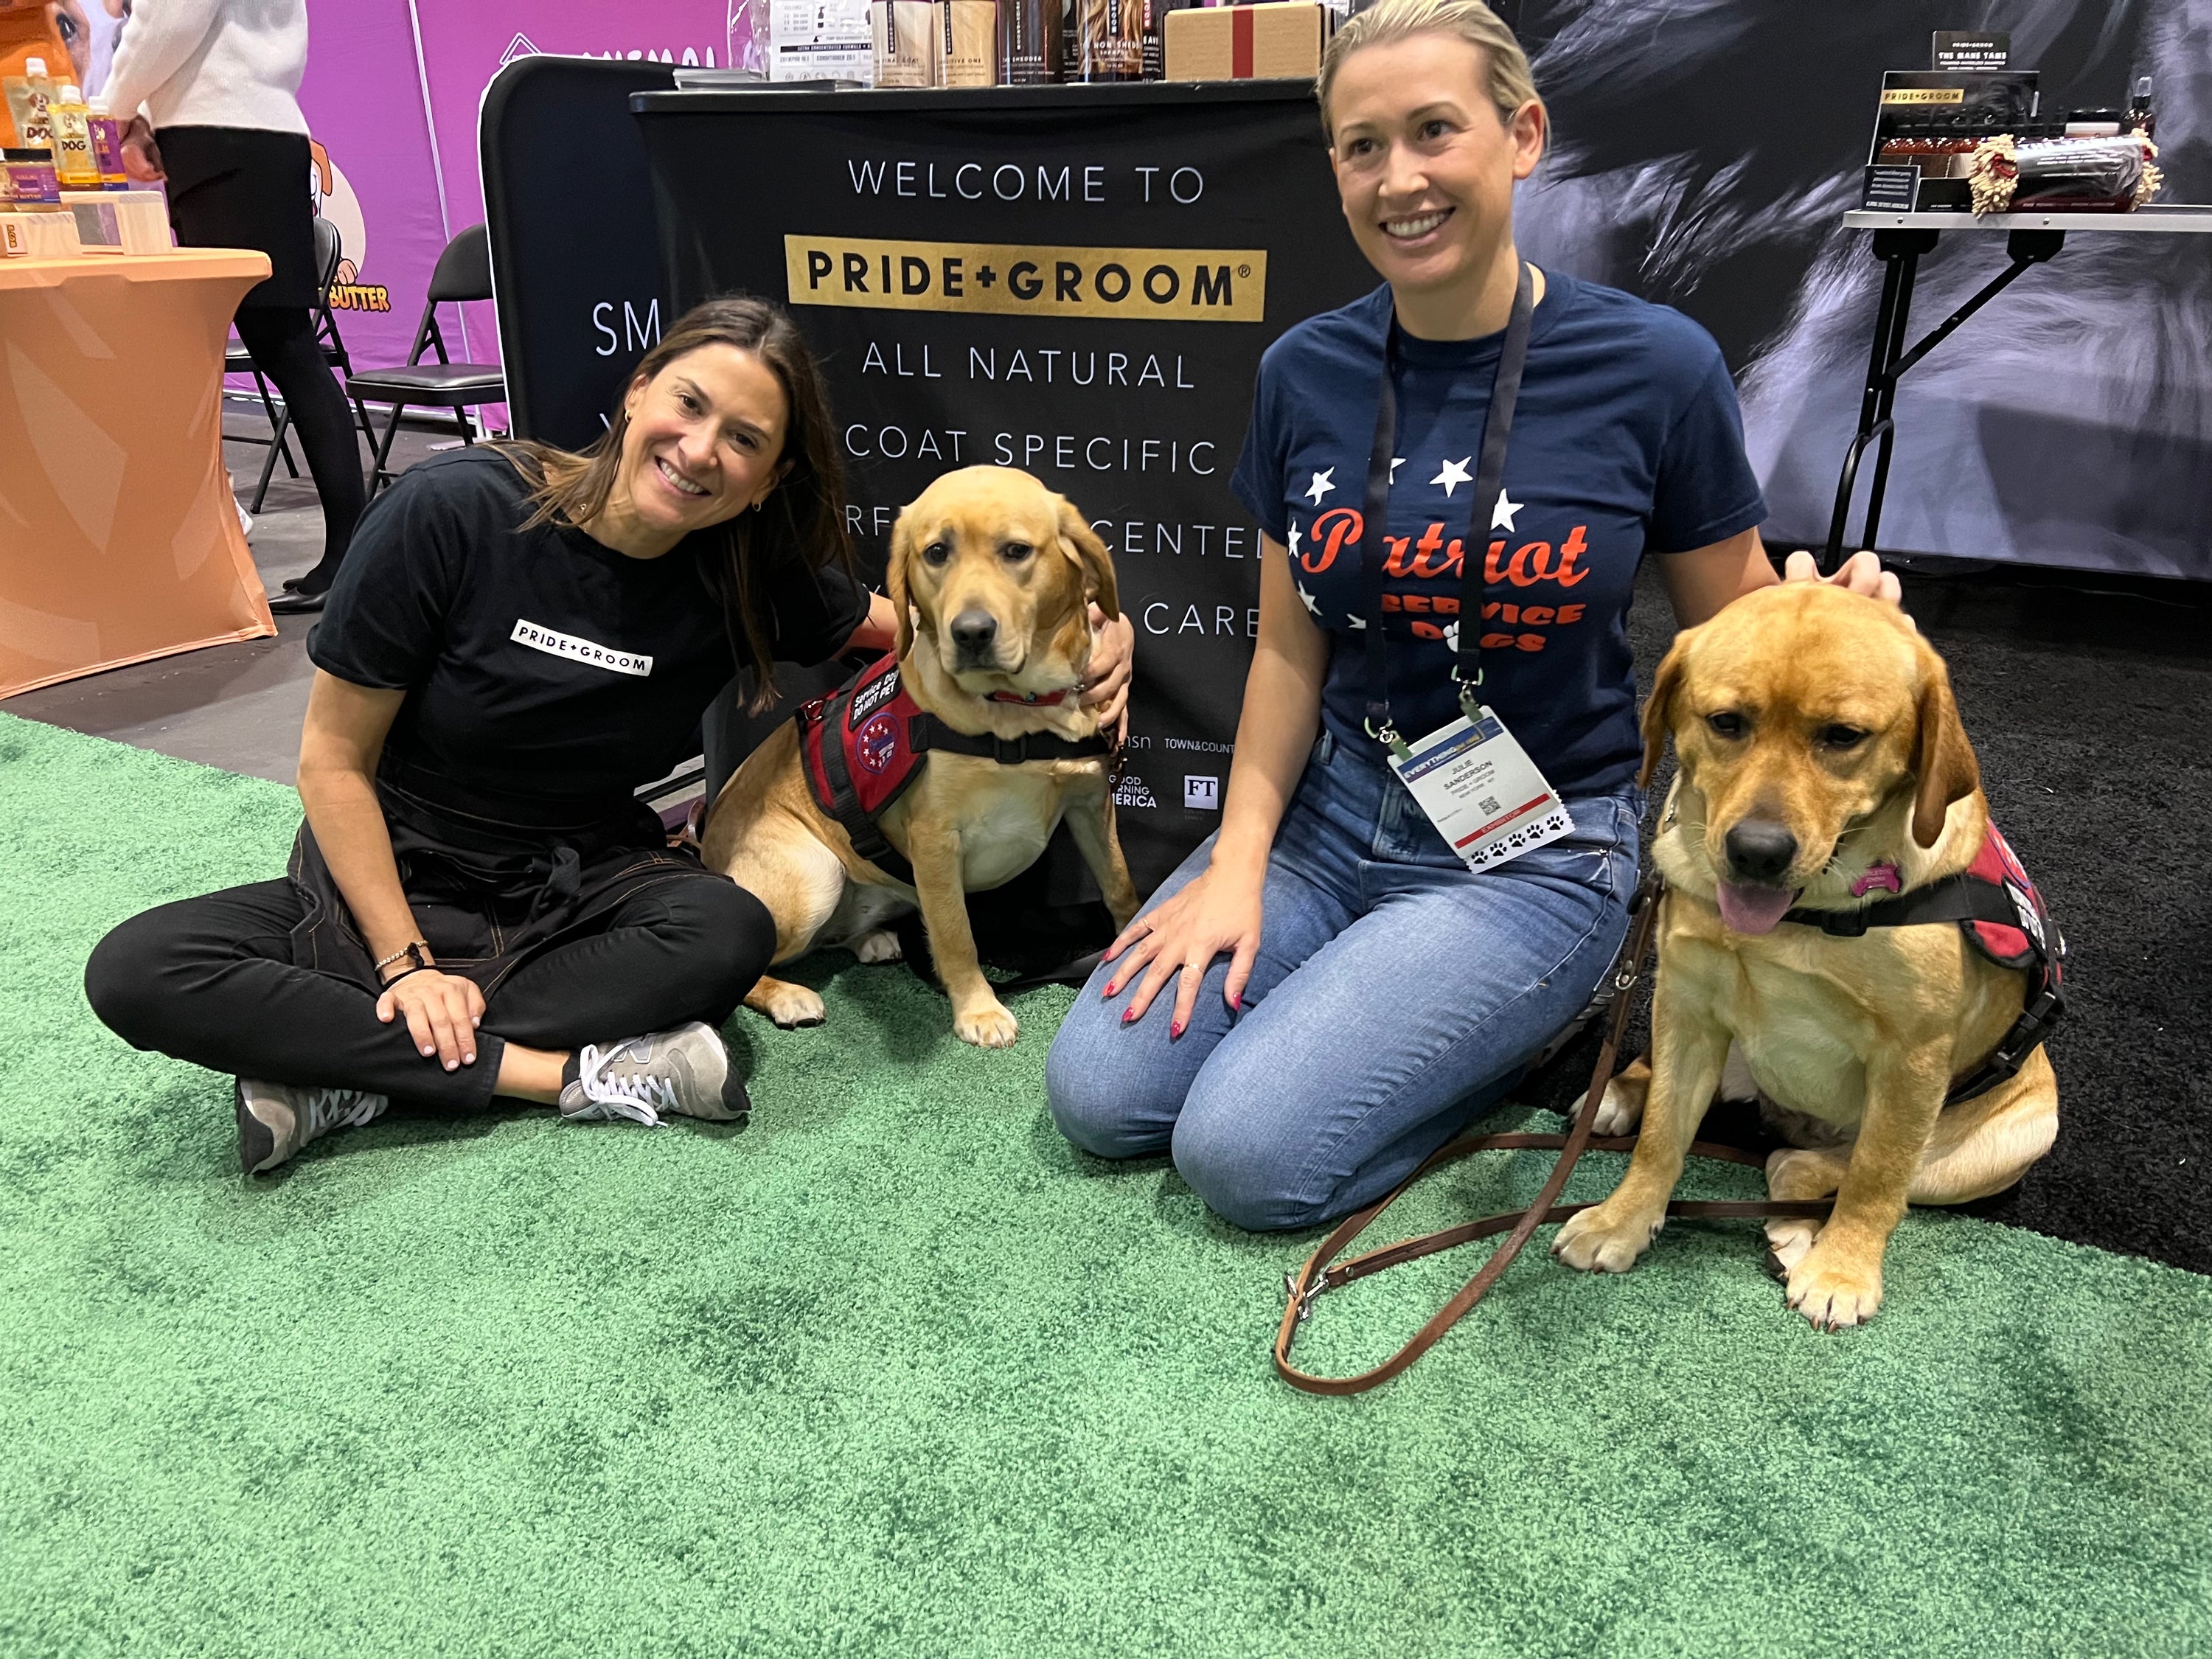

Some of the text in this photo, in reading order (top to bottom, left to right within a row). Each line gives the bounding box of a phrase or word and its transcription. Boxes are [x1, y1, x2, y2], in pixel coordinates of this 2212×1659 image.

[1885, 92, 1959, 101] PRIDE+GROOM
[61, 139, 86, 150] DOG
[848, 159, 1204, 204] WELCOME TO
[329, 285, 390, 310] BUTTER
[862, 341, 1194, 389] ALL NATURAL
[845, 423, 1216, 475] COAT SPECIFIC
[1091, 519, 1262, 559] CENTE
[518, 626, 645, 671] PRIDE+GROOM
[853, 681, 896, 720] DO NOT PET
[854, 681, 882, 708] Service
[1164, 737, 1236, 754] TOWN&COUNT
[1444, 760, 1492, 790] SANDERSON
[1451, 759, 1474, 775] JULIE
[1186, 779, 1216, 797] FT
